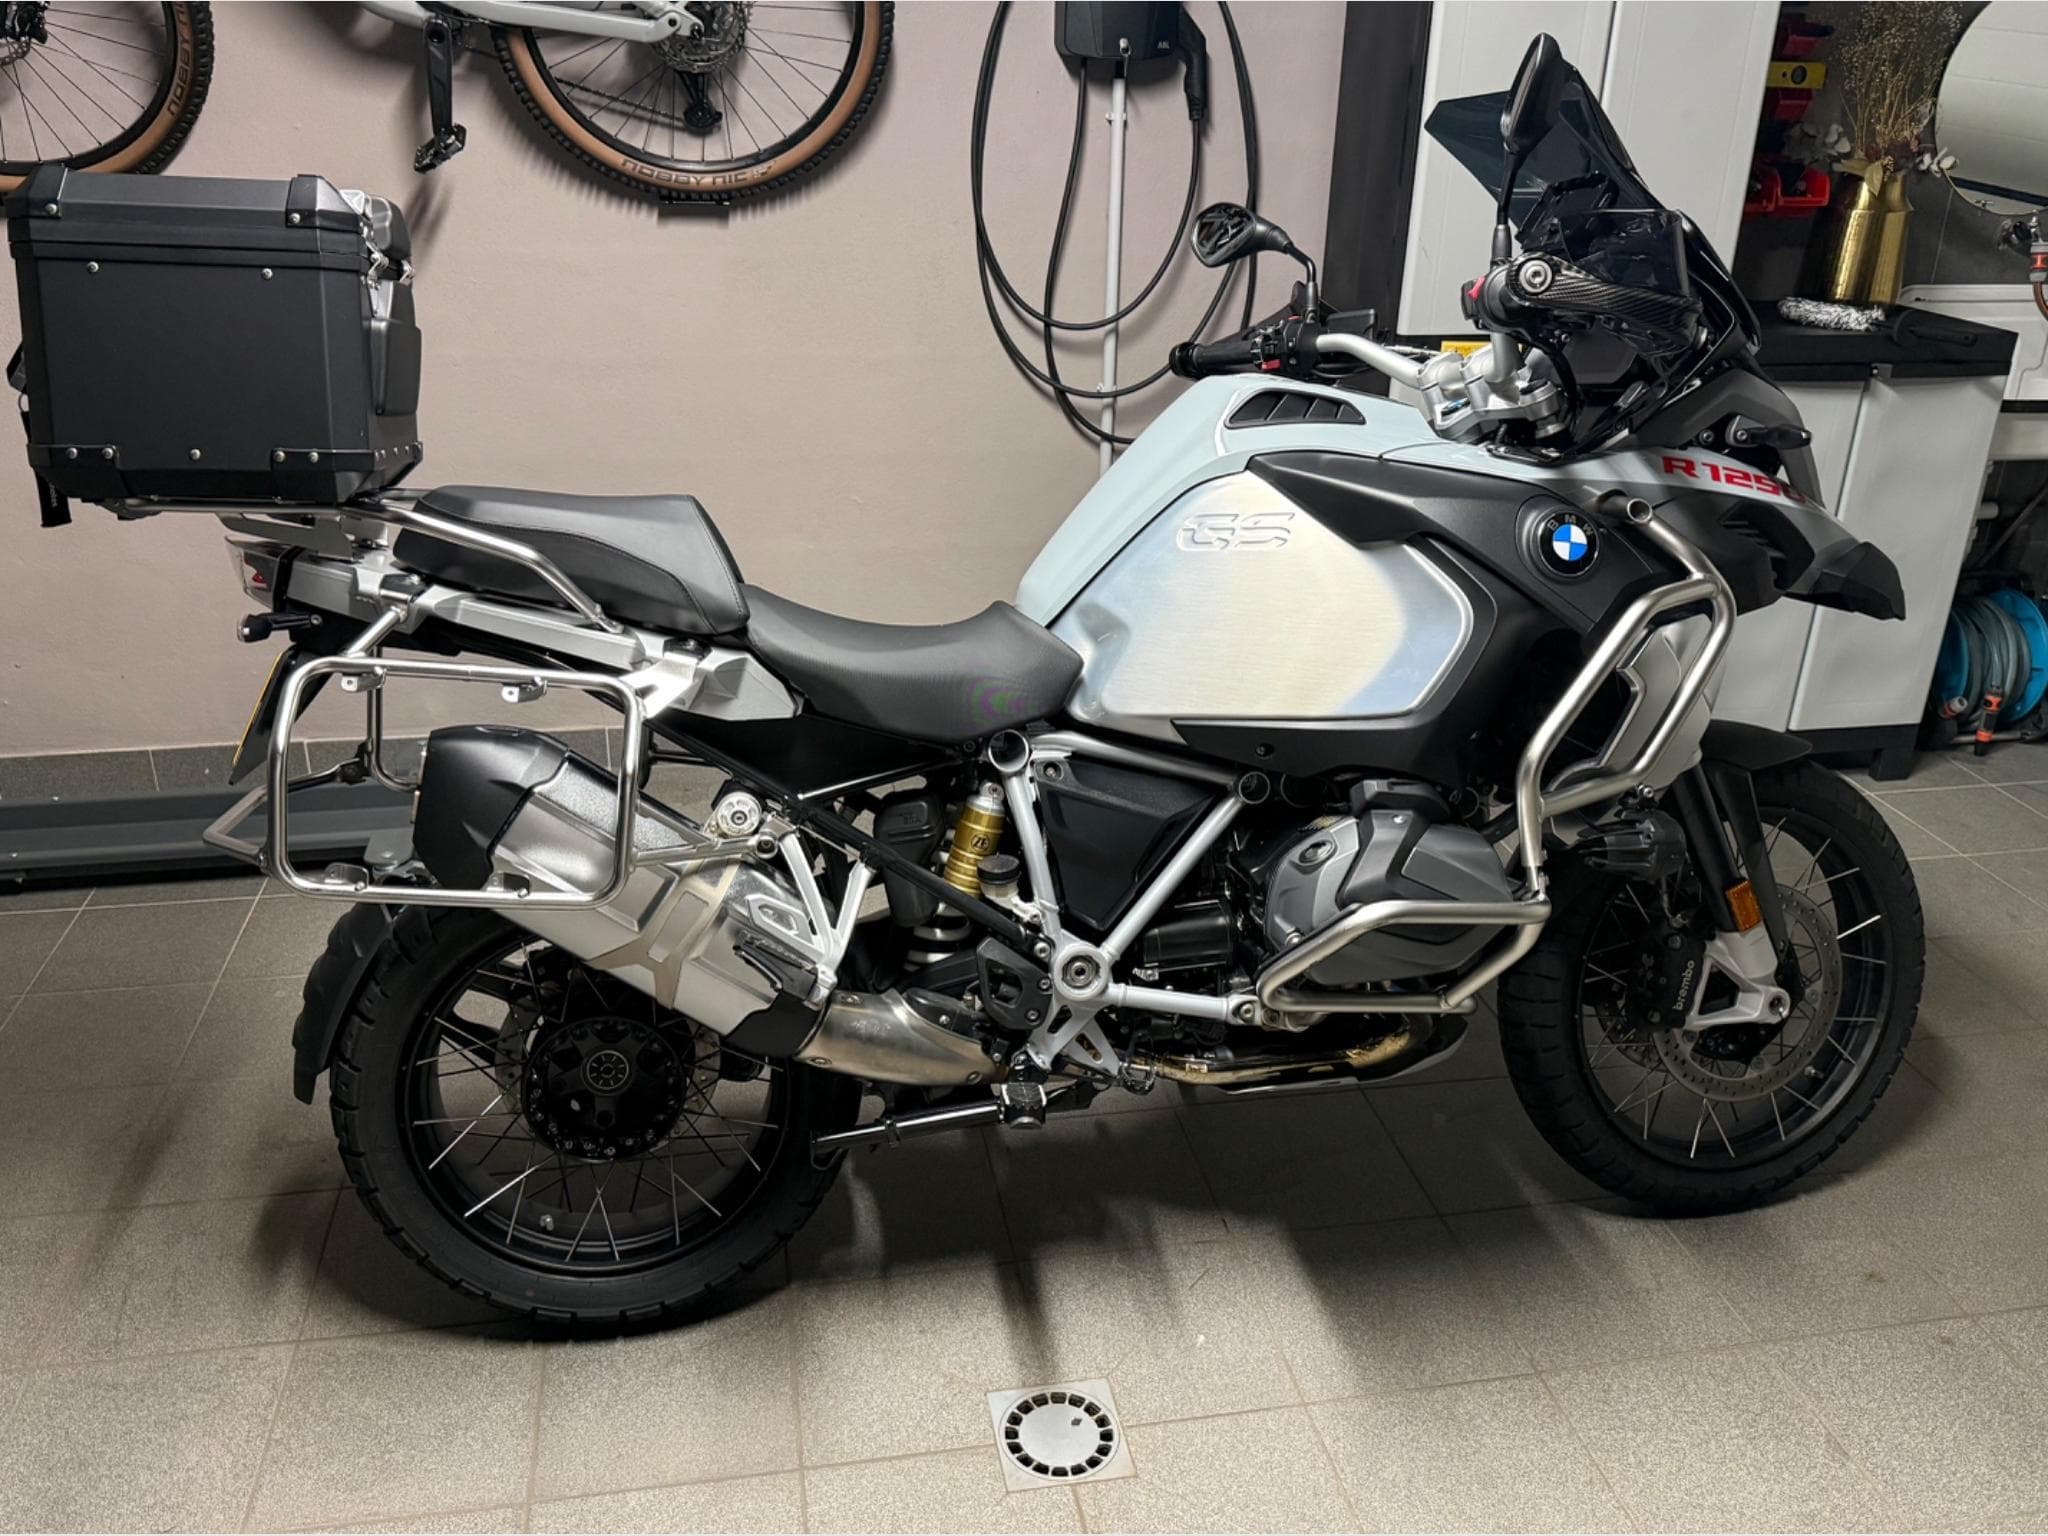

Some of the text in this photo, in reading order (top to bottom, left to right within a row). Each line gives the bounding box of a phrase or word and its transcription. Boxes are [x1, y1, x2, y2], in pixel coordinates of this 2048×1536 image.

[621, 158, 747, 186] NOBBY NIC
[1662, 456, 1699, 479] R
[1177, 511, 1295, 551] GS
[1547, 513, 1593, 535] BMW
[1672, 960, 1695, 1010] brembo
